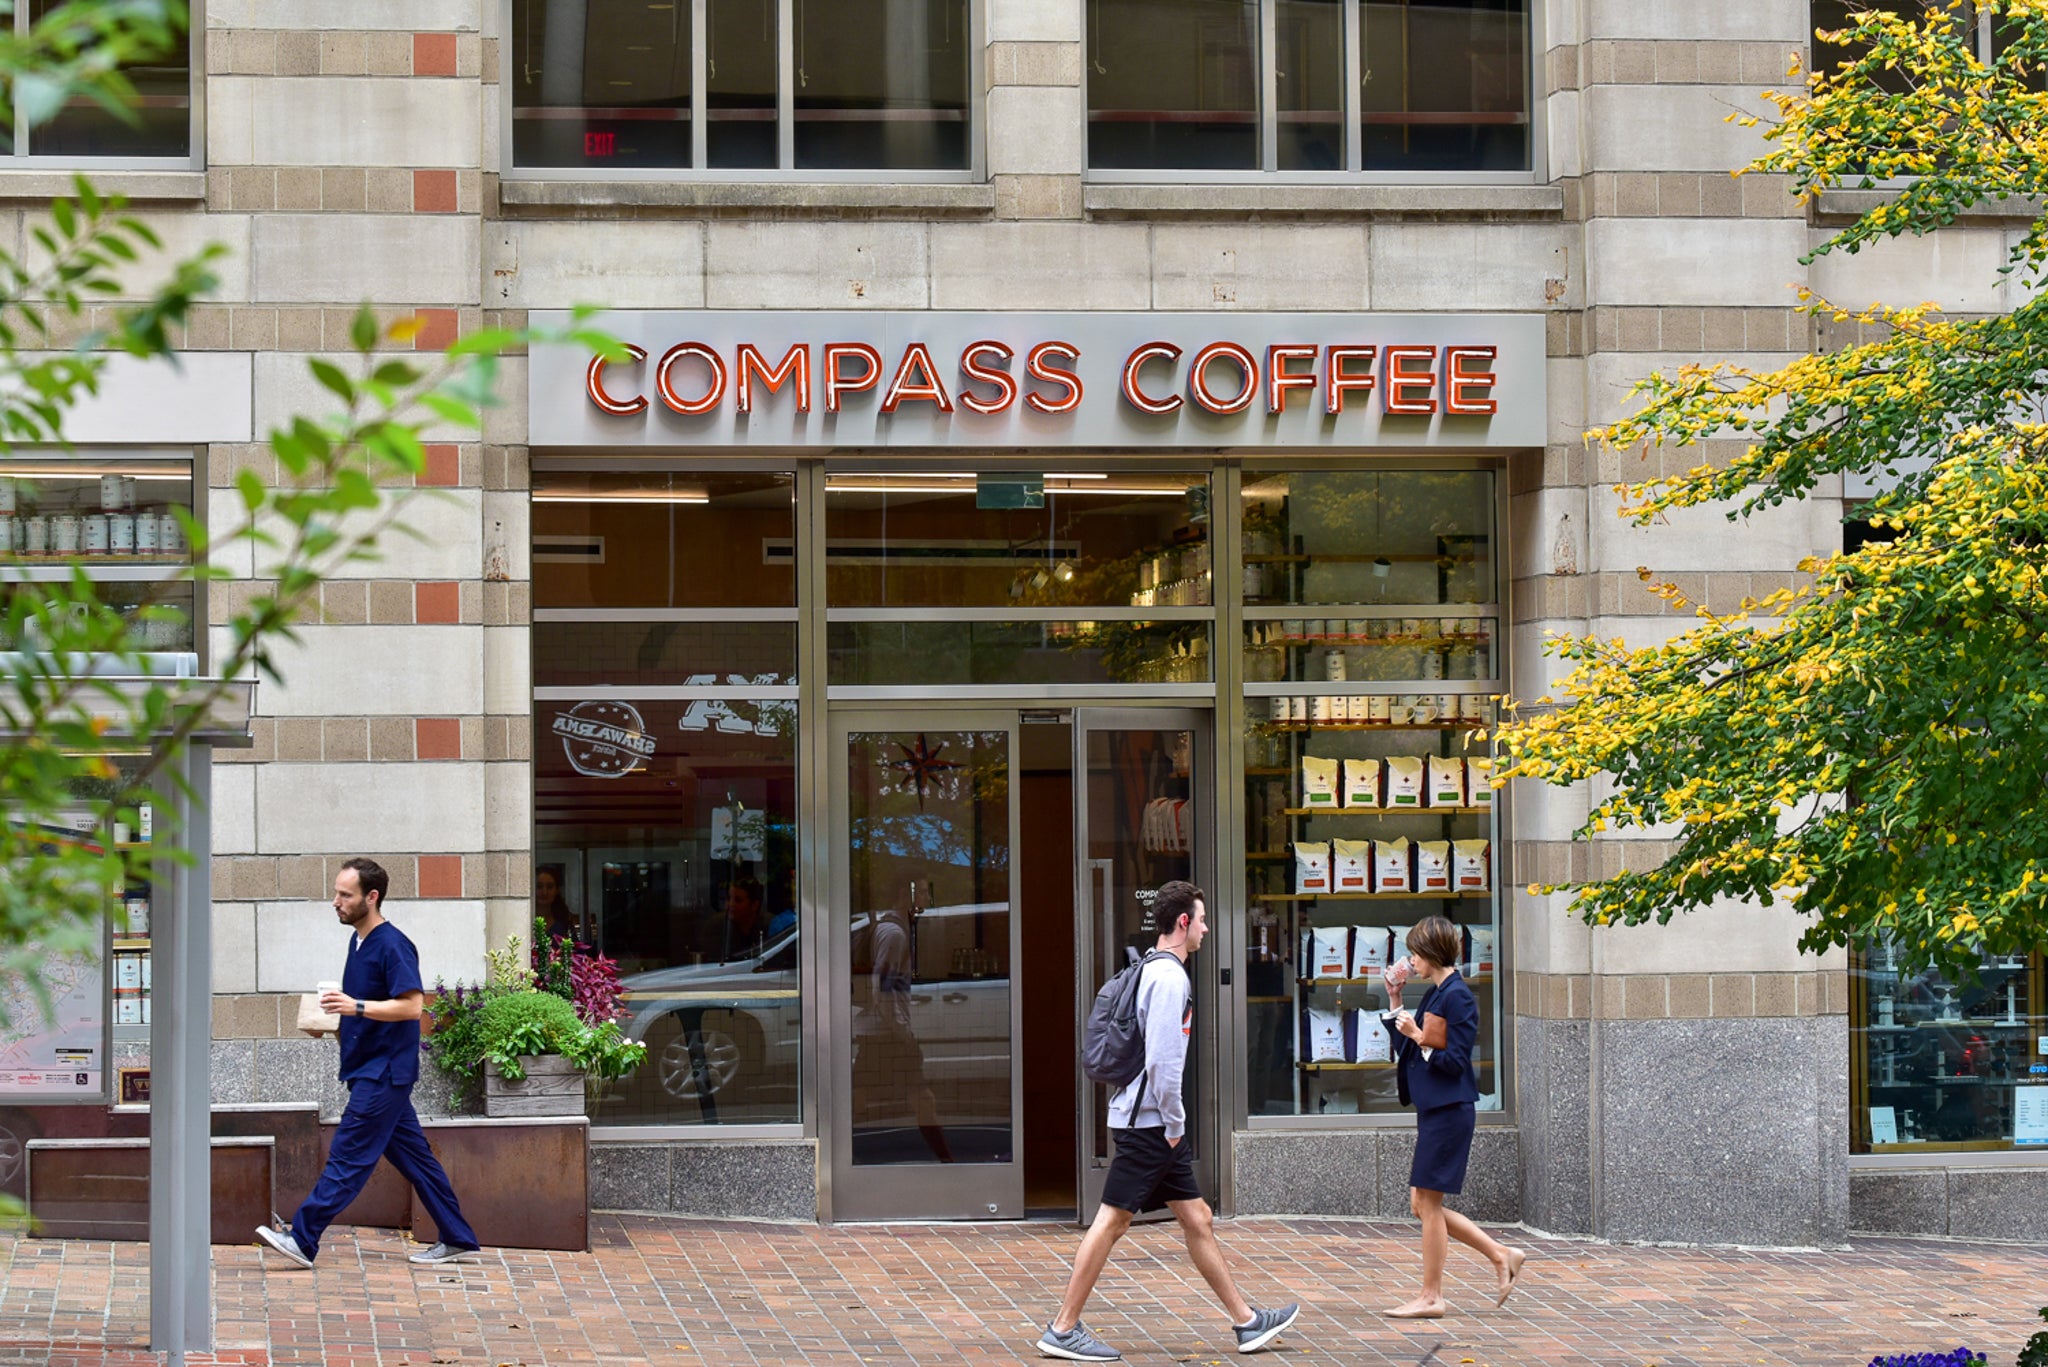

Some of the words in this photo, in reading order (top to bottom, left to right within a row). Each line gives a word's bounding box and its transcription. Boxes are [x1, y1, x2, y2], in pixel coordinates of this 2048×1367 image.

[584, 132, 615, 156] EXIT
[586, 339, 1085, 416] COMPASS
[1121, 340, 1498, 416] COFFEE
